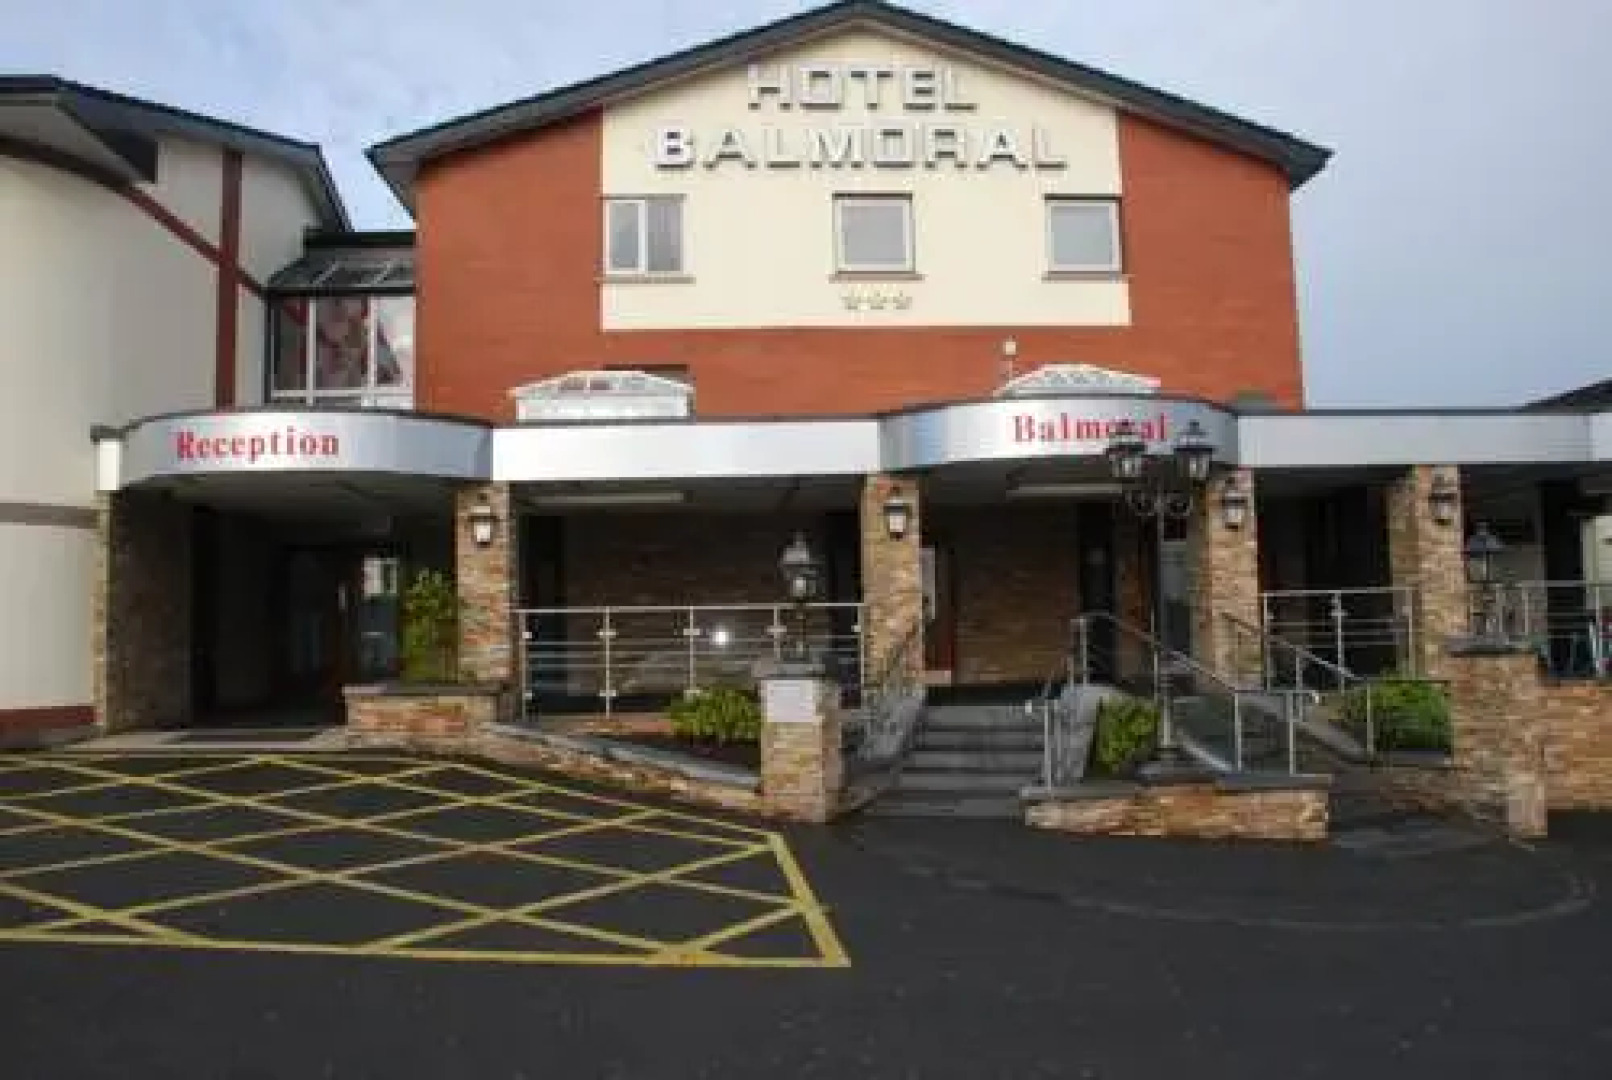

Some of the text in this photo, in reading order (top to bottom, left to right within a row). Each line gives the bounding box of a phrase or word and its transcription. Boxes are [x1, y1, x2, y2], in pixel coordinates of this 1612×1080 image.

[747, 64, 977, 110] HOTEL
[653, 125, 1067, 169] BALMORAL
[176, 427, 339, 464] Reception
